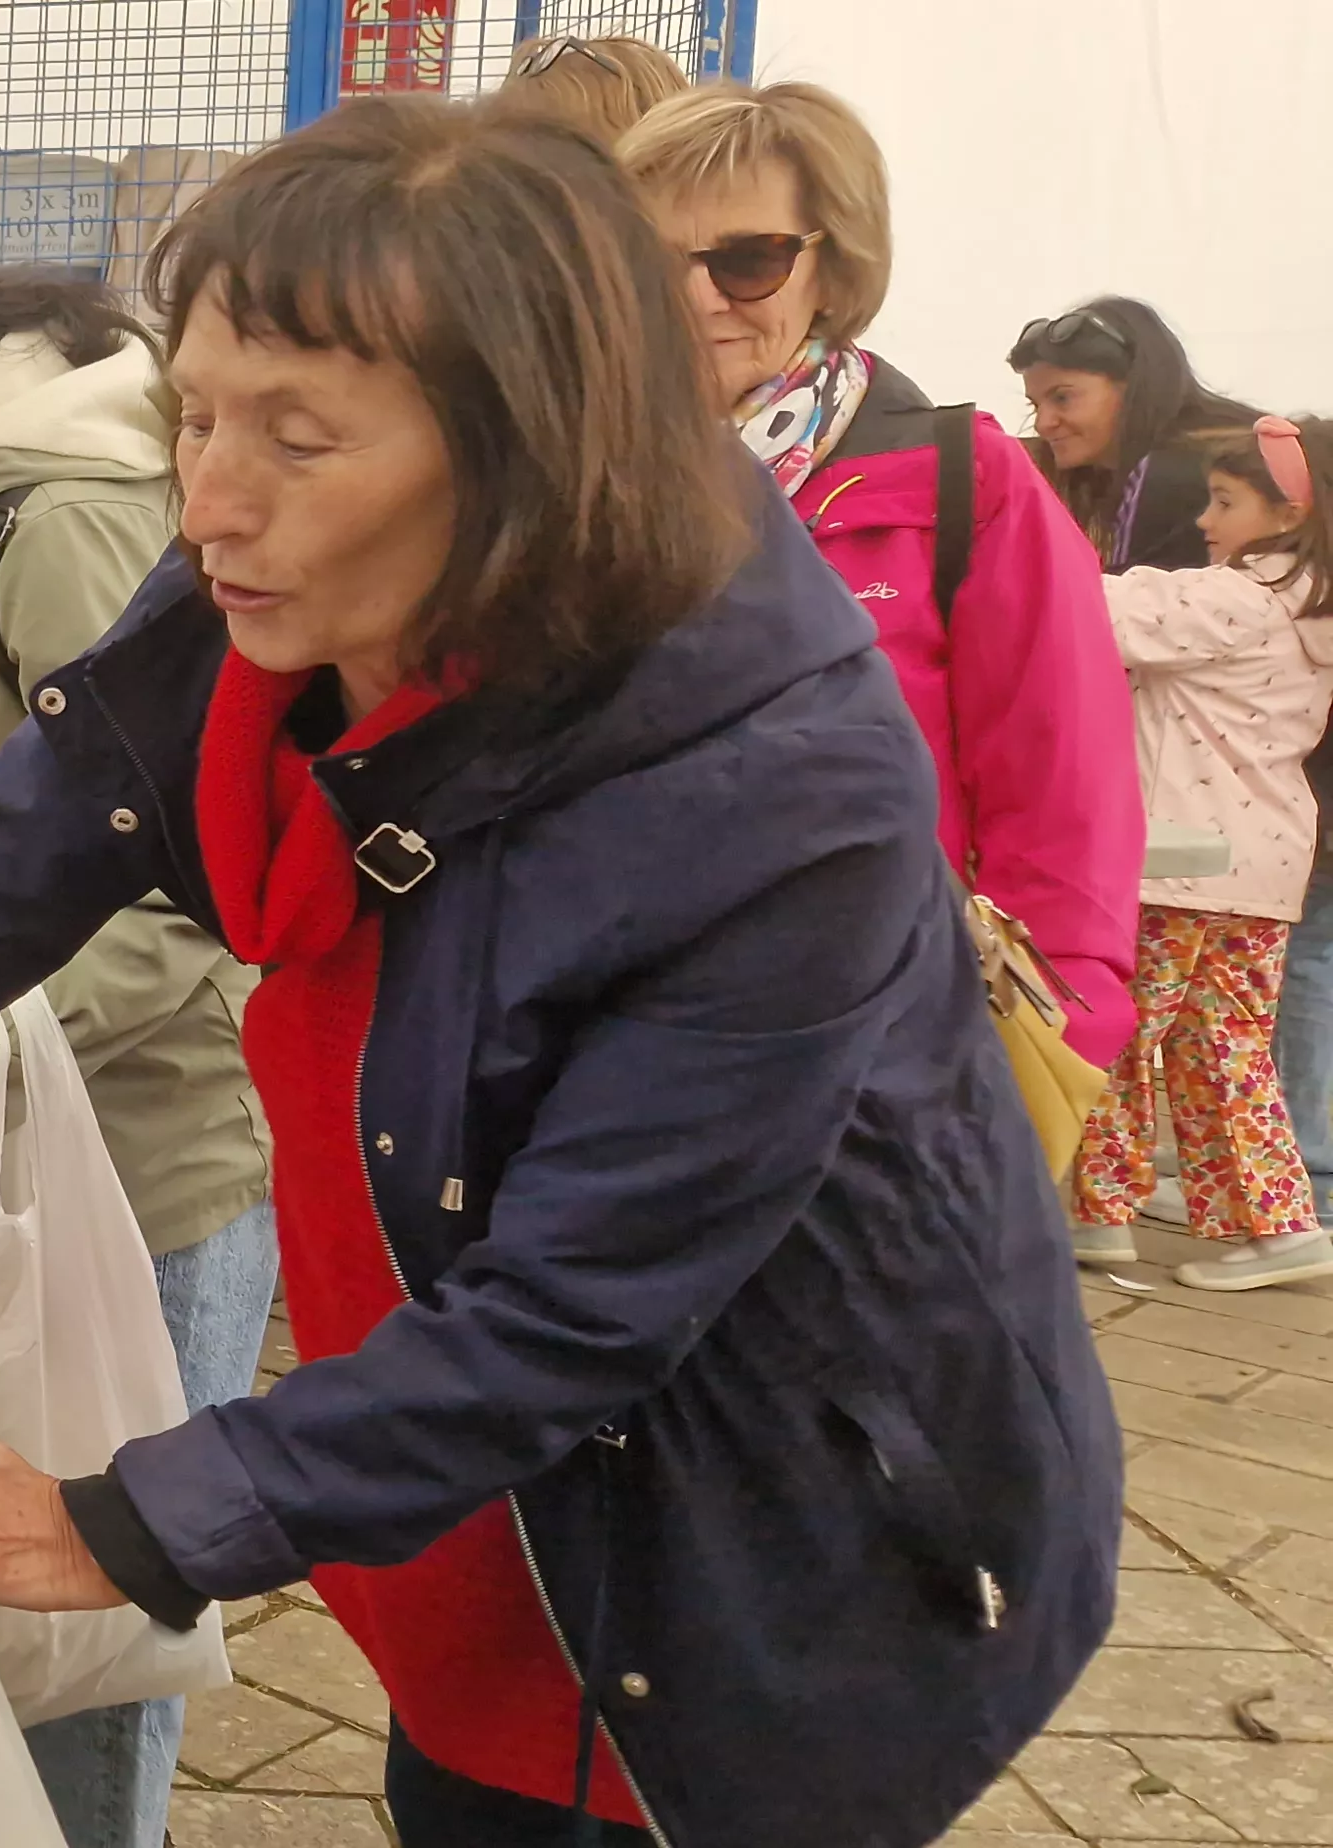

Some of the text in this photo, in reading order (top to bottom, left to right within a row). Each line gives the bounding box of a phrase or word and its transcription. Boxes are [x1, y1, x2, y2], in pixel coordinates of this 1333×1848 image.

[20, 188, 99, 211] 3 x 3m
[45, 222, 59, 237] x
